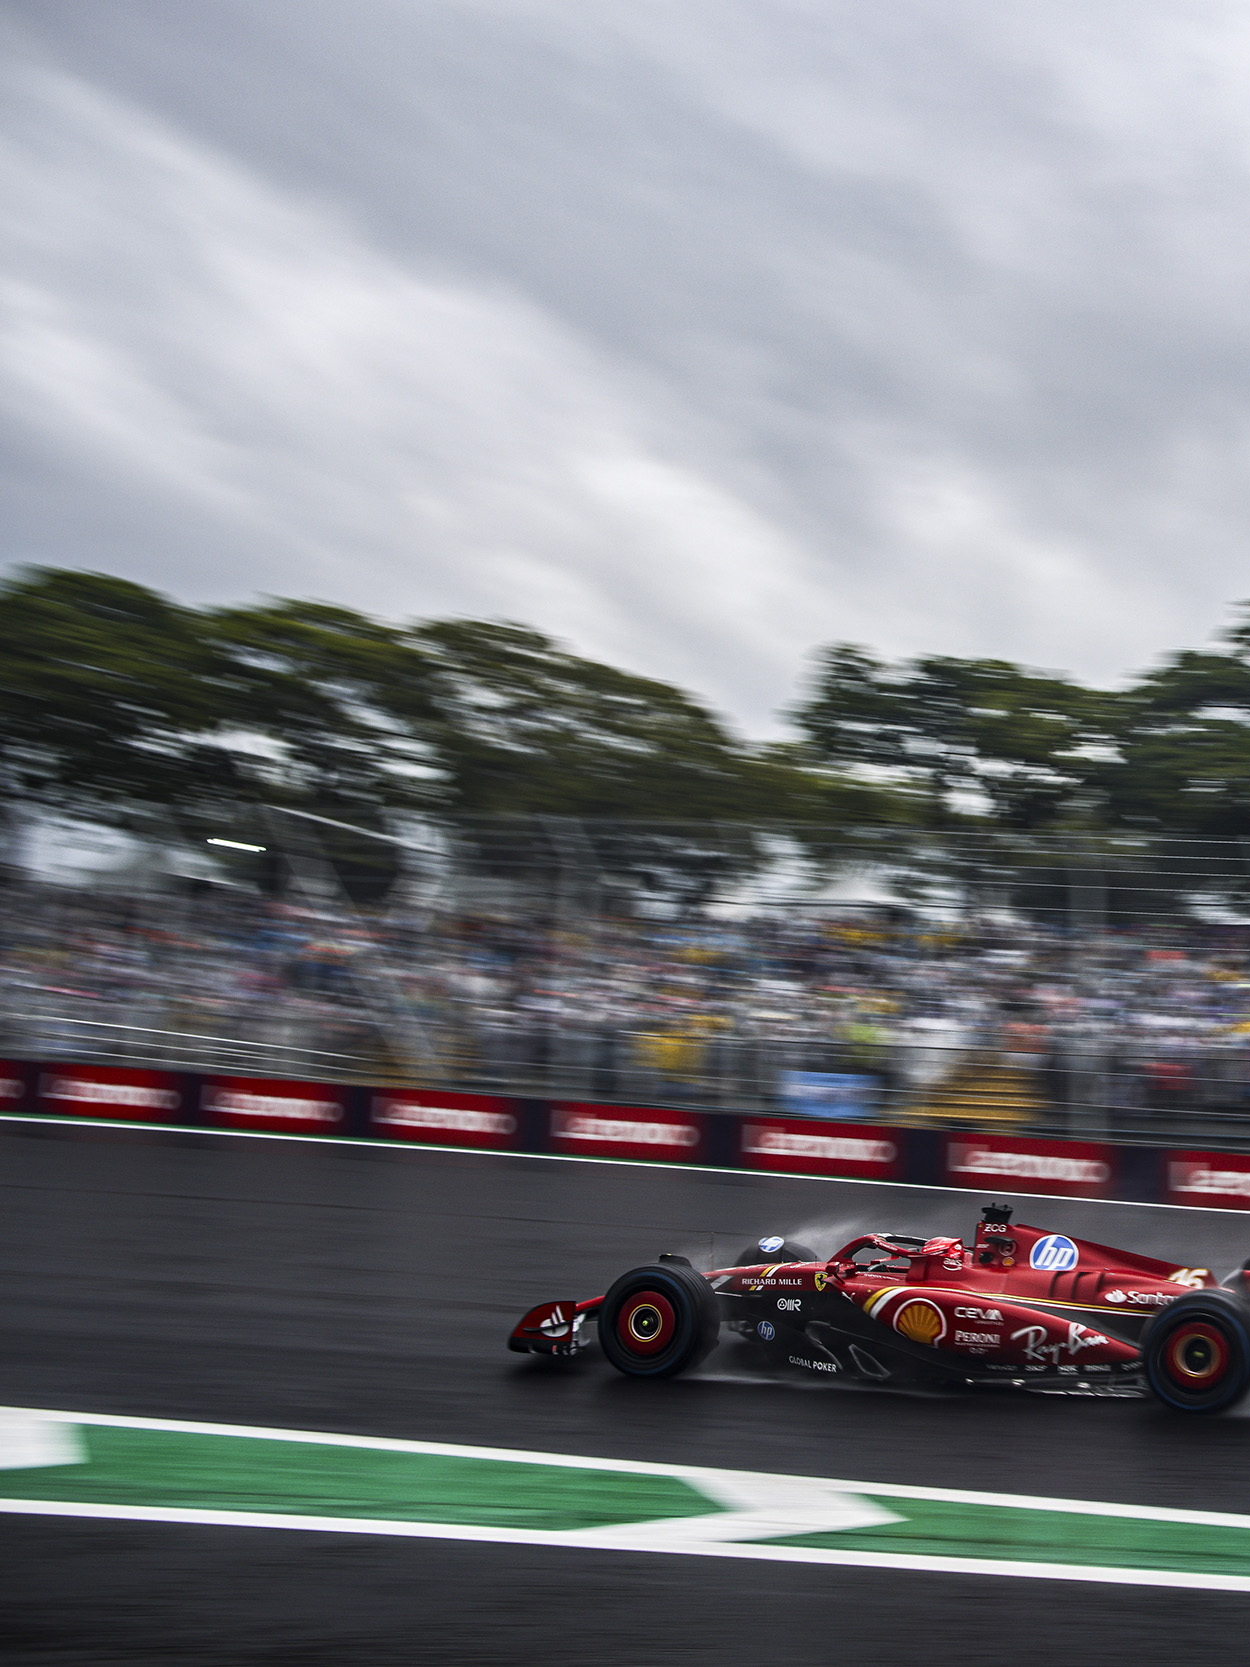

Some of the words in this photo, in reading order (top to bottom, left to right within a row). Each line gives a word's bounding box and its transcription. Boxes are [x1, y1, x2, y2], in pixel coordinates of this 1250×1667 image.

[984, 1223, 1007, 1232] ZCG
[1034, 1235, 1076, 1270] hp
[741, 1278, 777, 1286] RICHARD
[778, 1278, 802, 1286] MILLE
[759, 1321, 774, 1340] hp
[955, 1330, 1000, 1344] PERONI
[789, 1355, 812, 1369] GLOBAL
[812, 1361, 837, 1373] POKER
